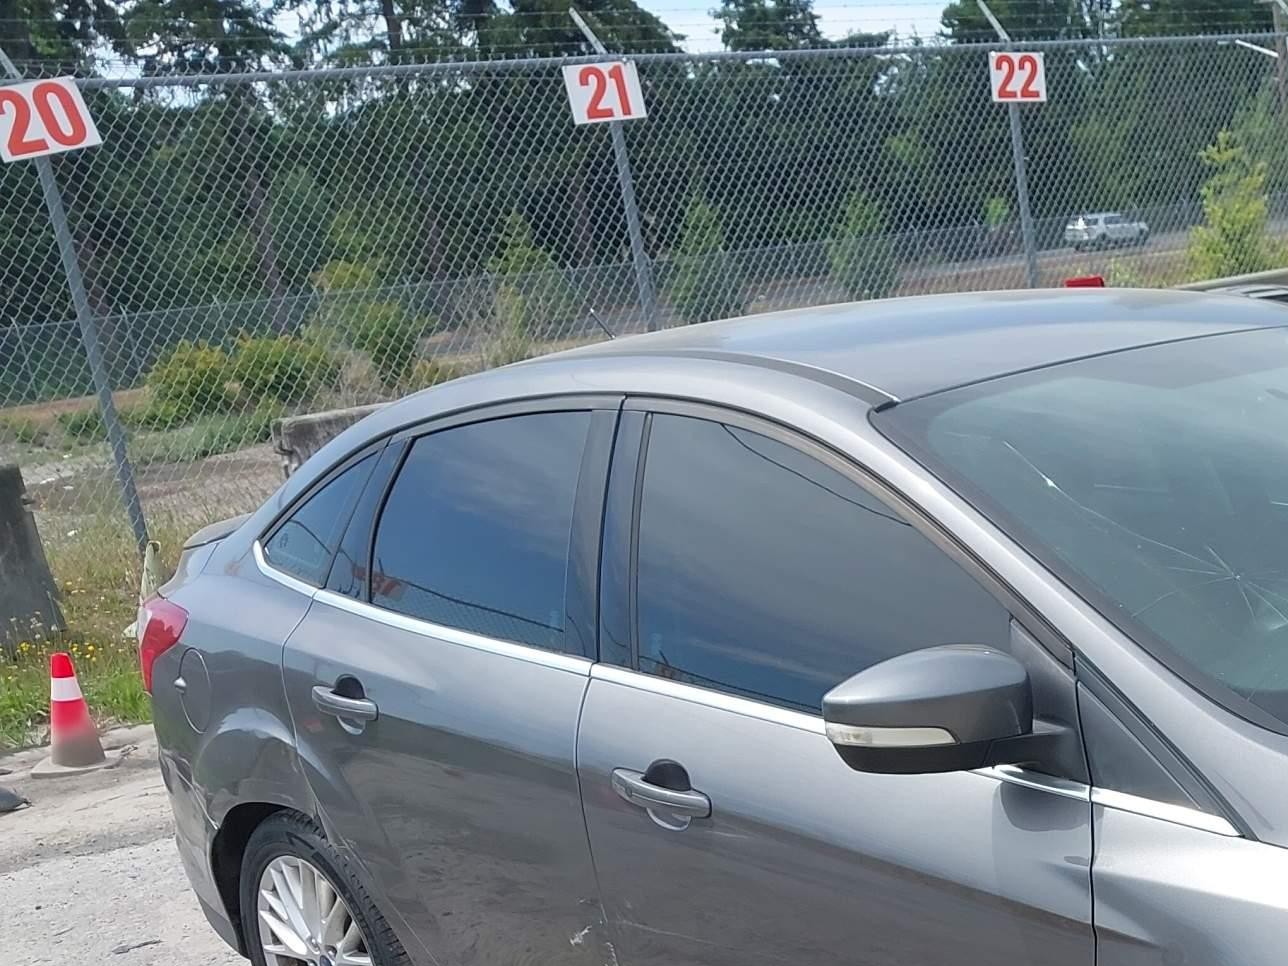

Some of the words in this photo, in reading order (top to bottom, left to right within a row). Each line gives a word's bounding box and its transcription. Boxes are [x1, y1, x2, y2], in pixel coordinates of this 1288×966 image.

[579, 65, 632, 119] 21
[995, 54, 1040, 100] 22
[0, 82, 86, 156] 20
